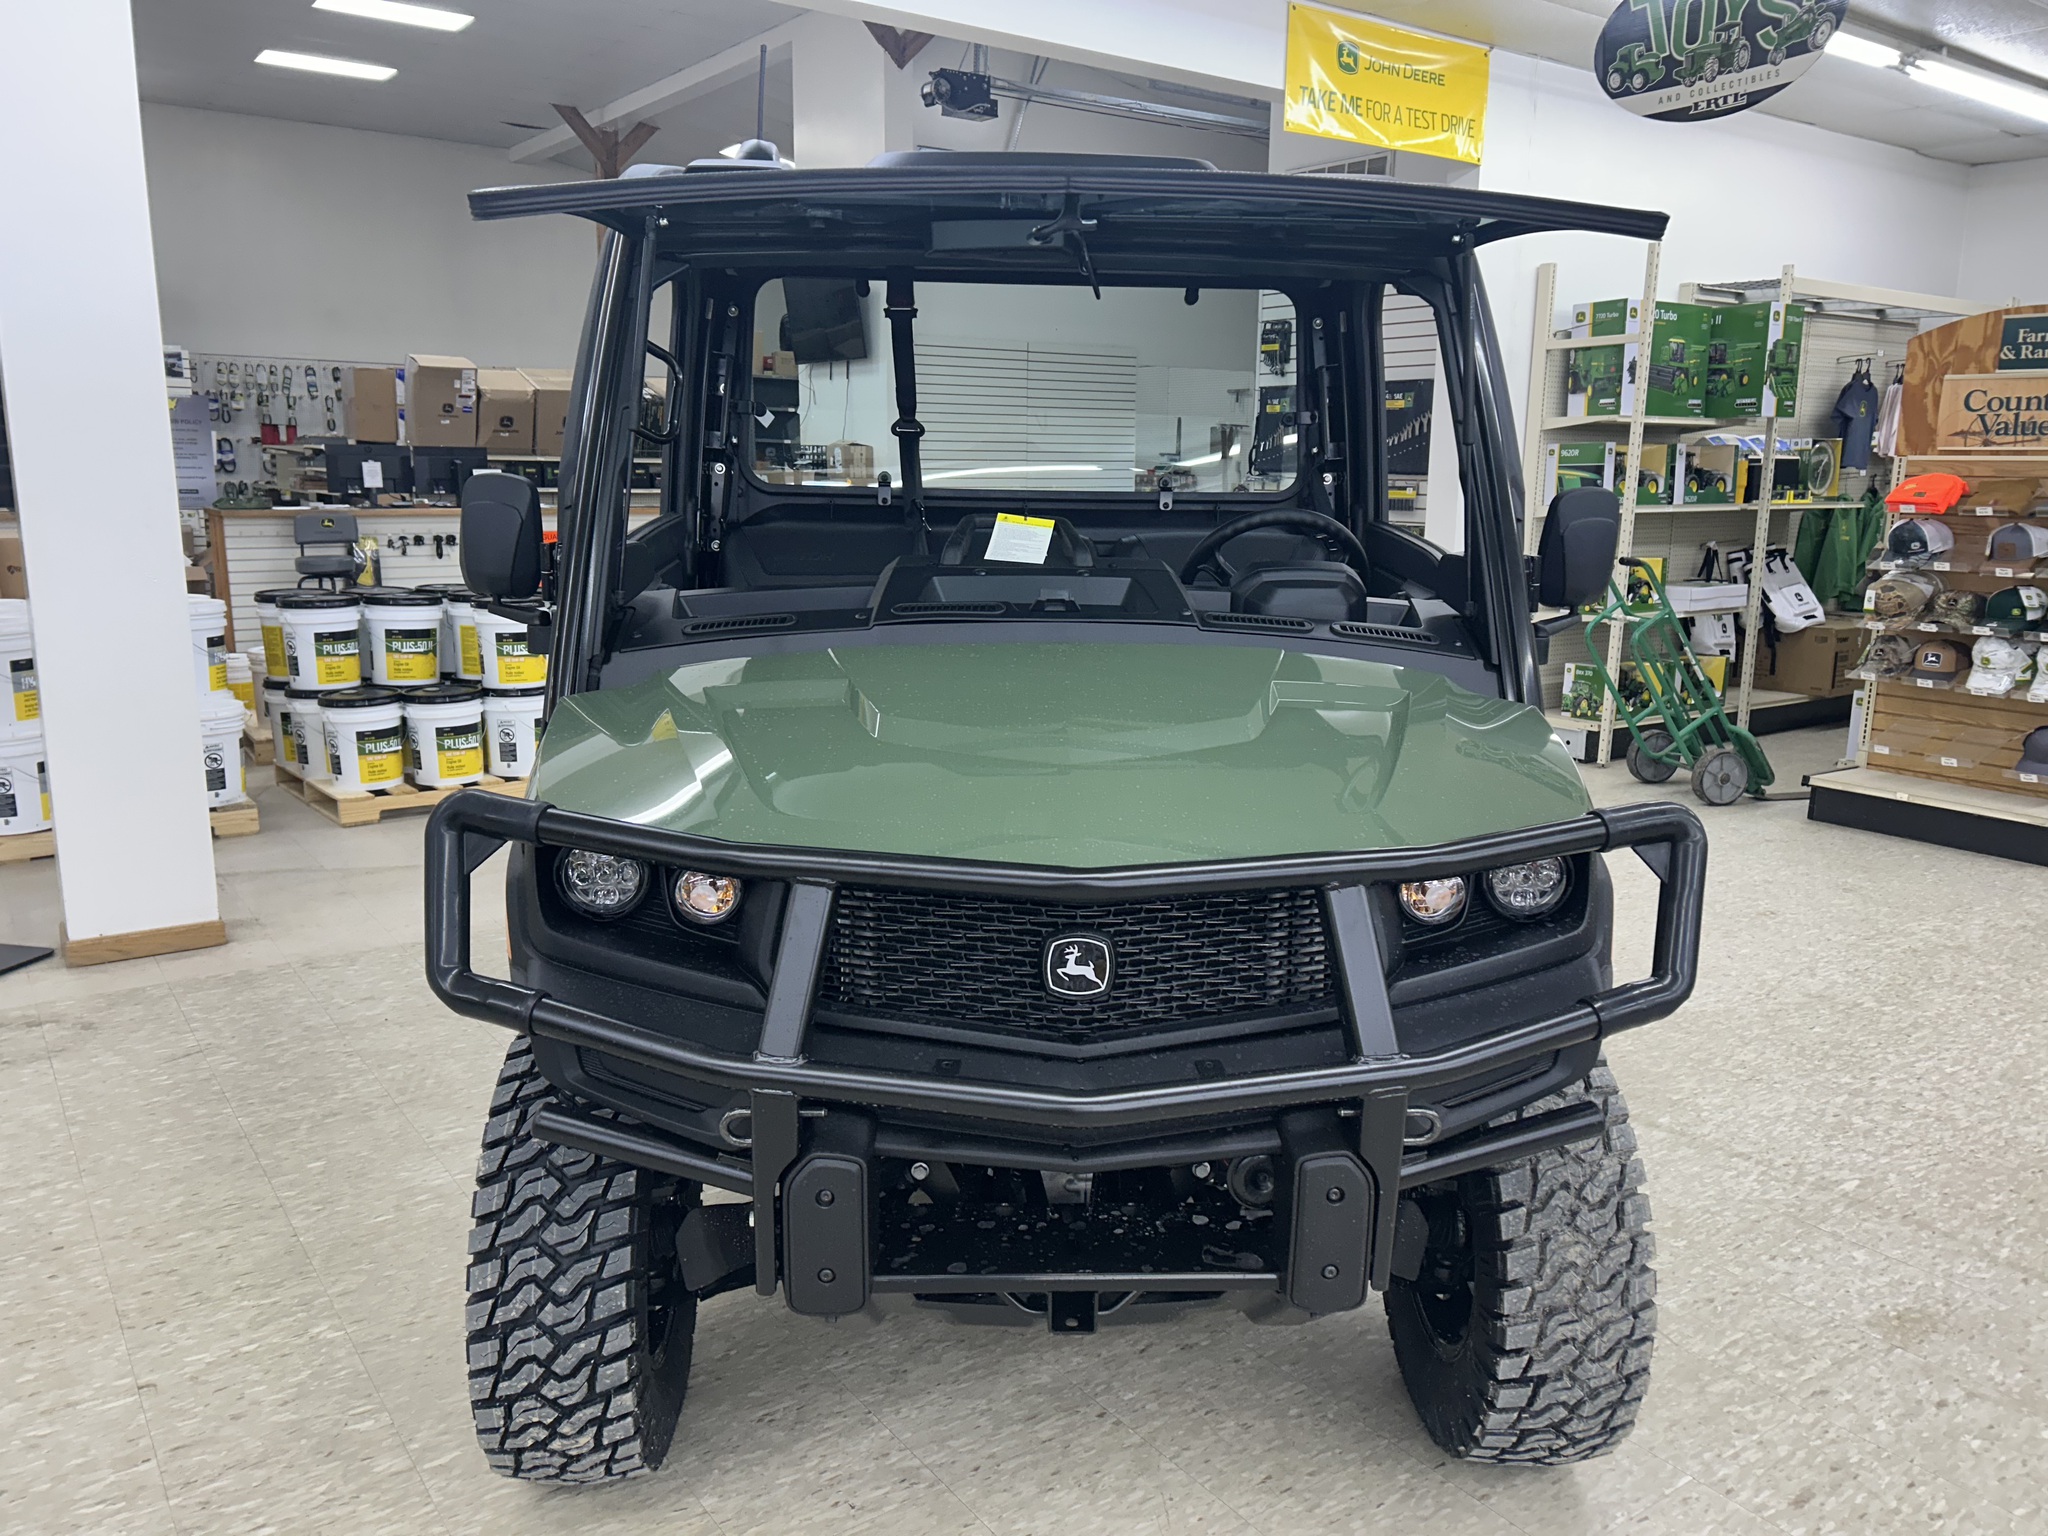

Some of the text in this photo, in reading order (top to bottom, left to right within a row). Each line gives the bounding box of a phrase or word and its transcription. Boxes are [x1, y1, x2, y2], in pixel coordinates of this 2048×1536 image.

[1364, 55, 1446, 87] JOHN DEERE
[1657, 68, 1782, 105] AND COLLECTIBLES
[1689, 92, 1747, 115] ERTL
[1299, 85, 1477, 139] TAKE ME FOR A TEST DRIVE
[1660, 309, 1678, 321] Turbo
[2000, 345, 2016, 360] &
[1560, 449, 1579, 457] 9620R
[392, 641, 427, 652] PLUS-50
[444, 735, 476, 749] PLUS-50
